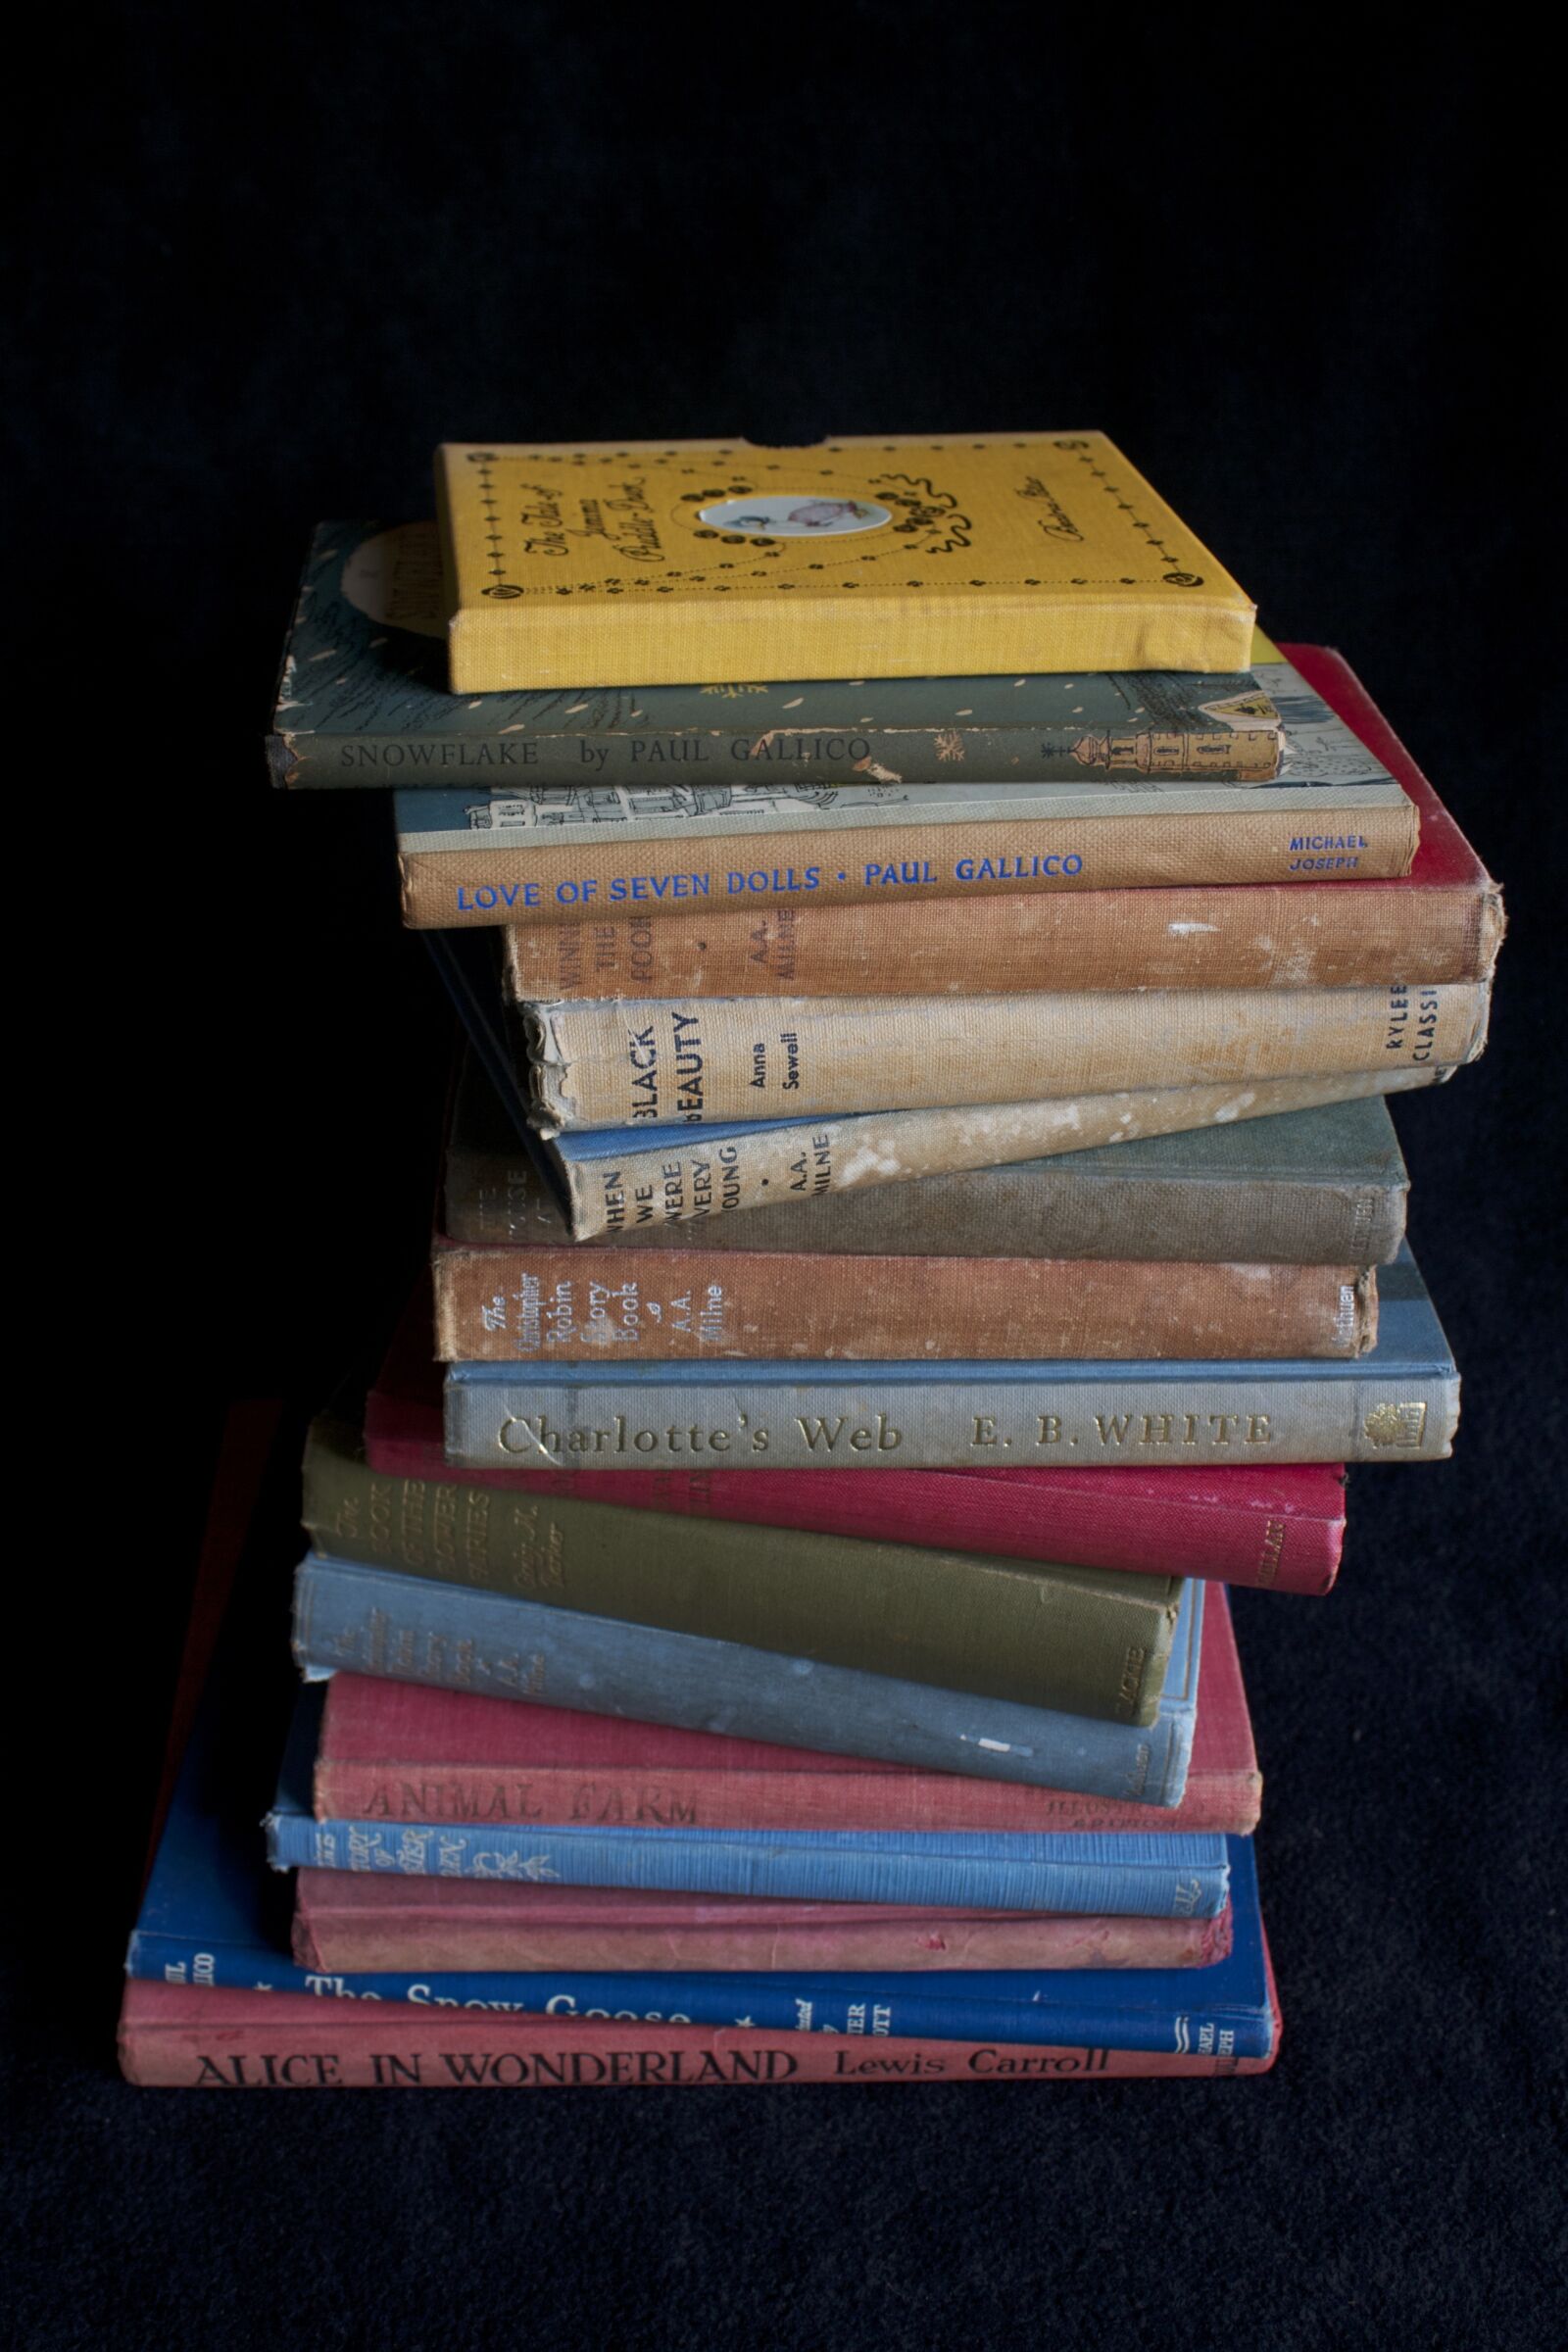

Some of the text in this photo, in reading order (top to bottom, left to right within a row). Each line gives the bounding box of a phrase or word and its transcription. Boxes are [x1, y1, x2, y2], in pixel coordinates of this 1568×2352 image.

[521, 502, 563, 528] Tale
[523, 531, 568, 557] The
[342, 737, 870, 770] SNOWFLAKE by PAUL GALLICO
[1290, 835, 1368, 851] MICHAEL
[458, 855, 1083, 910] LOVE OF SEVEN DOLLS PAUL GALLICO
[1290, 857, 1358, 871] JOSEPH
[555, 921, 581, 990] WINN
[1412, 990, 1438, 1061] CLASSI
[750, 1043, 766, 1089] Anna
[780, 1032, 799, 1090] Sewell
[692, 1160, 711, 1218] VERY
[790, 1152, 807, 1192] A.A.
[636, 1184, 654, 1223] WE
[481, 1294, 507, 1332] The
[547, 1280, 576, 1345] Robin
[612, 1282, 640, 1342] Book
[670, 1290, 693, 1333] A.A.
[699, 1285, 723, 1342] Milne
[498, 1413, 1272, 1453] Charlotte's Web E. B. WHITE
[364, 1783, 699, 1824] ANIMAL FARM
[196, 2048, 1110, 2085] ALICE IN WONDERLAND Lewis Carroll
